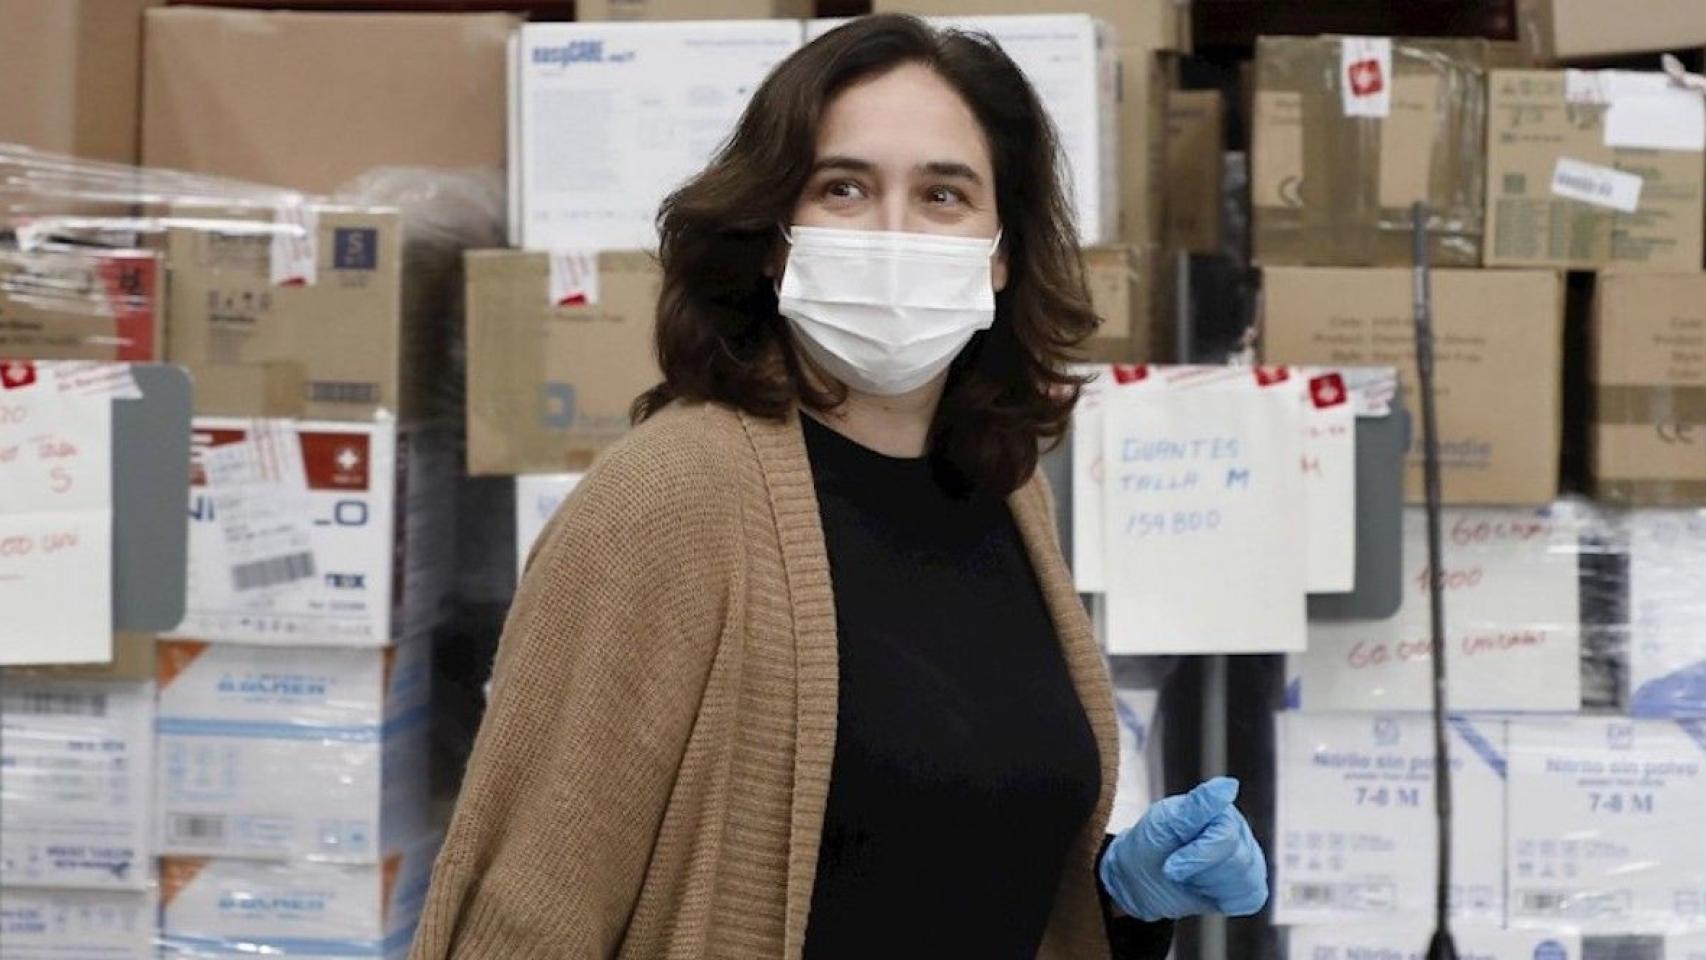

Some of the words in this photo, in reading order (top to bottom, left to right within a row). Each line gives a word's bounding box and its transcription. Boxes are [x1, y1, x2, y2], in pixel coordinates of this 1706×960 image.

[1225, 468, 1250, 490] M
[1398, 787, 1420, 807] M
[1632, 792, 1654, 814] M
